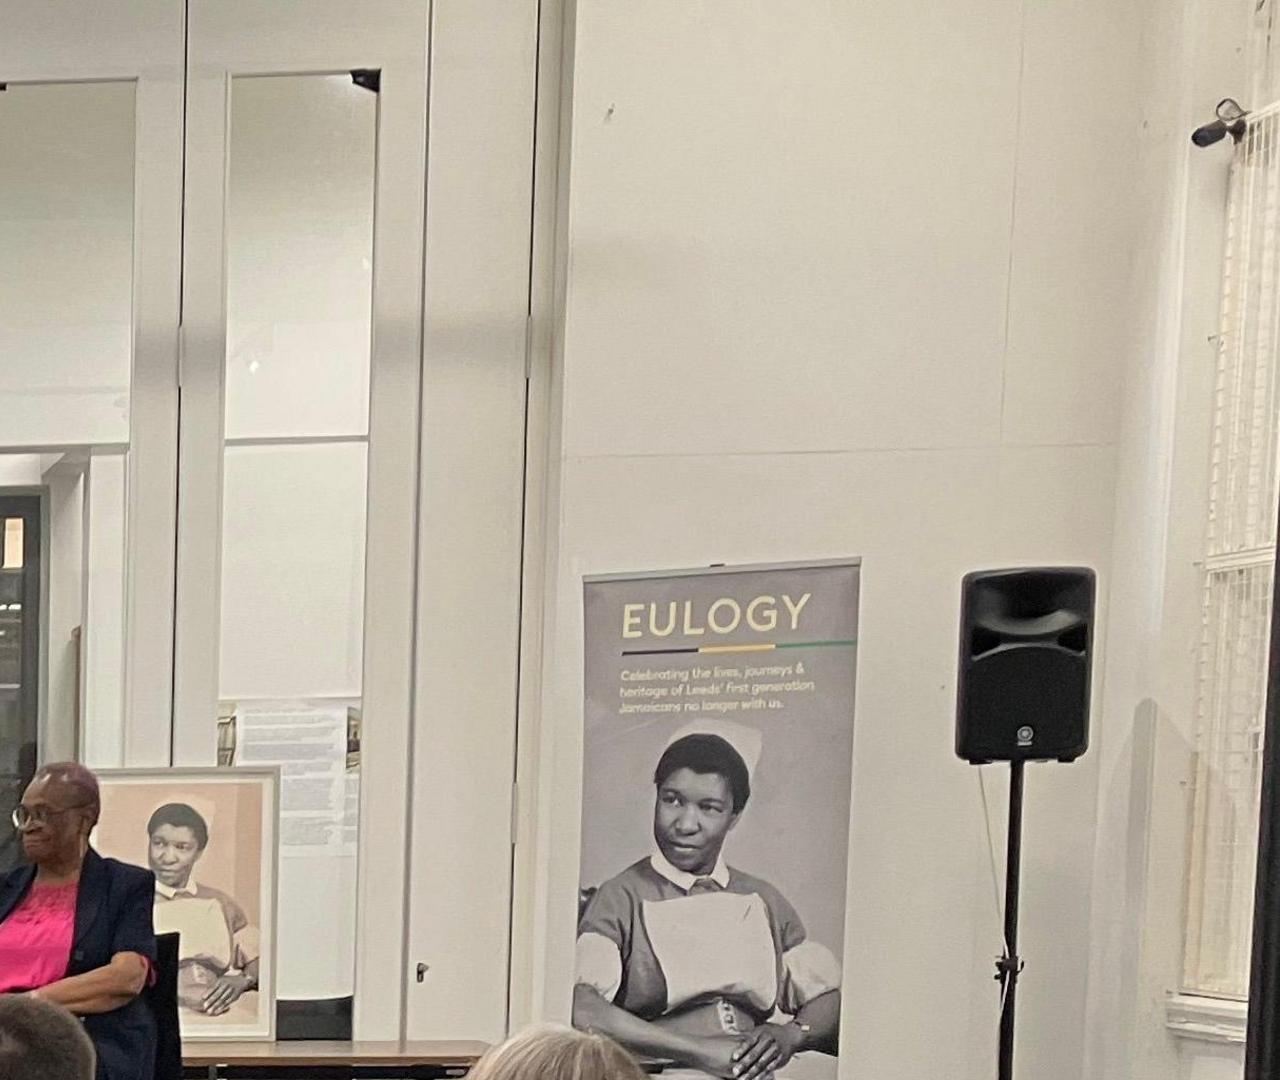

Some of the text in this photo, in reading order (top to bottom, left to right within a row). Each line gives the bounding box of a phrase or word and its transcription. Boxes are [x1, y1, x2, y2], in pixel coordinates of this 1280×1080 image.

[622, 593, 811, 638] EULOGY
[621, 668, 690, 682] Celebrating
[692, 665, 712, 679] the
[743, 664, 793, 680] journeys
[795, 661, 805, 674] &
[619, 685, 668, 699] heritage
[671, 683, 685, 696] of
[726, 681, 749, 694] first
[751, 680, 816, 696] generation
[619, 701, 681, 714] Jamaicans
[684, 702, 700, 712] no
[702, 700, 739, 713] longer
[741, 697, 767, 710] with
